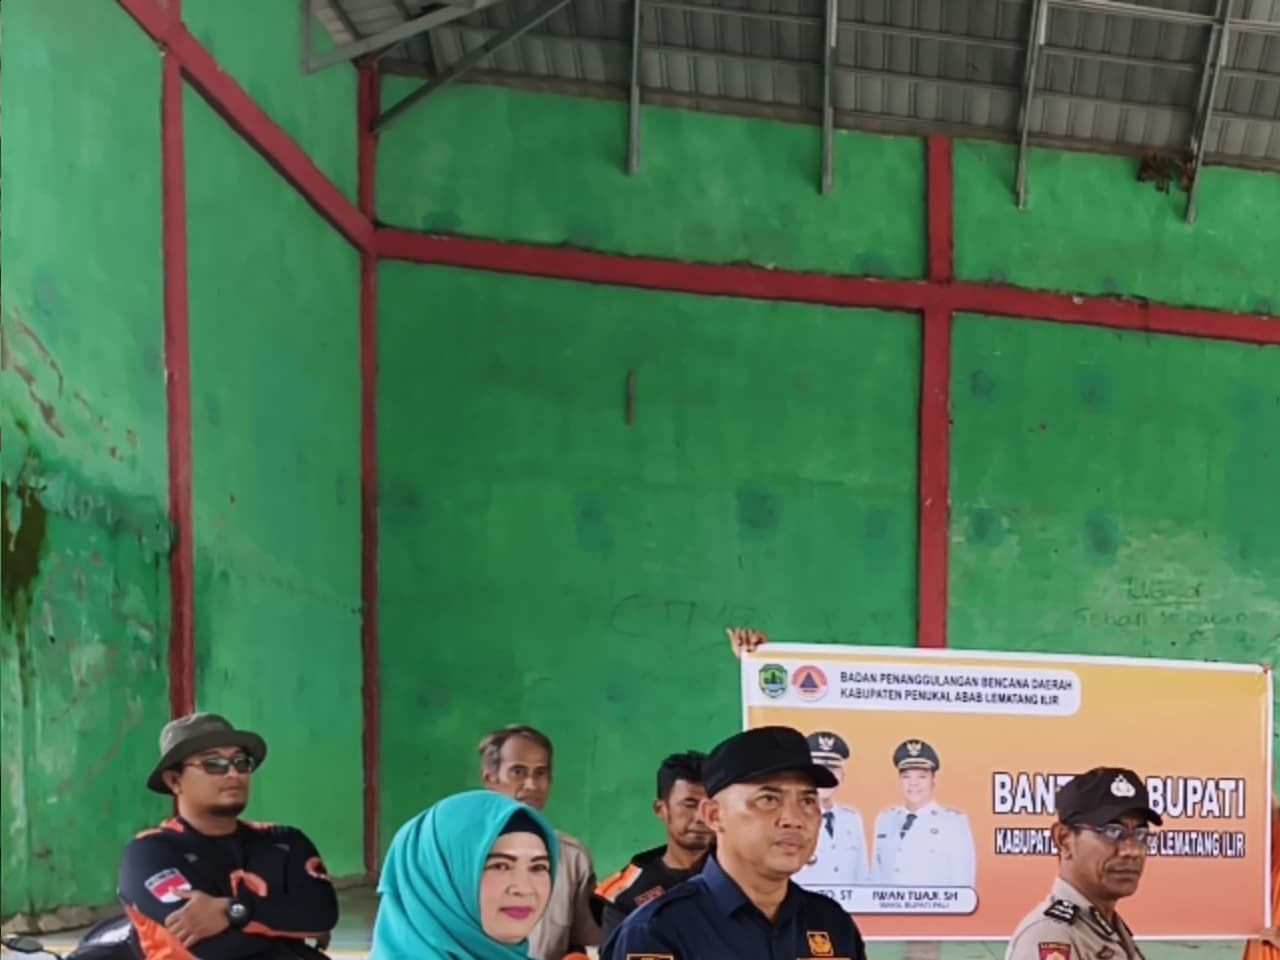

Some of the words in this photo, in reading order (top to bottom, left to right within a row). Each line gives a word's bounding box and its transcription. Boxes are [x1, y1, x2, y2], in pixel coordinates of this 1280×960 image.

[839, 670, 878, 684] BADAN
[879, 672, 980, 688] PENANGGULANGAN
[980, 677, 1030, 690] BENCANA
[1031, 678, 1073, 691] DAERAH
[839, 686, 902, 701] KABUPATEN
[903, 688, 952, 702] PENUKAL
[954, 690, 984, 703] ABAB
[984, 691, 1039, 705] LEMATANG
[1039, 693, 1061, 706] ILIR
[1145, 776, 1246, 819] BUPATI
[1159, 829, 1221, 858] LEMATANG
[1221, 831, 1246, 859] ILIR
[872, 890, 905, 901] IWAN
